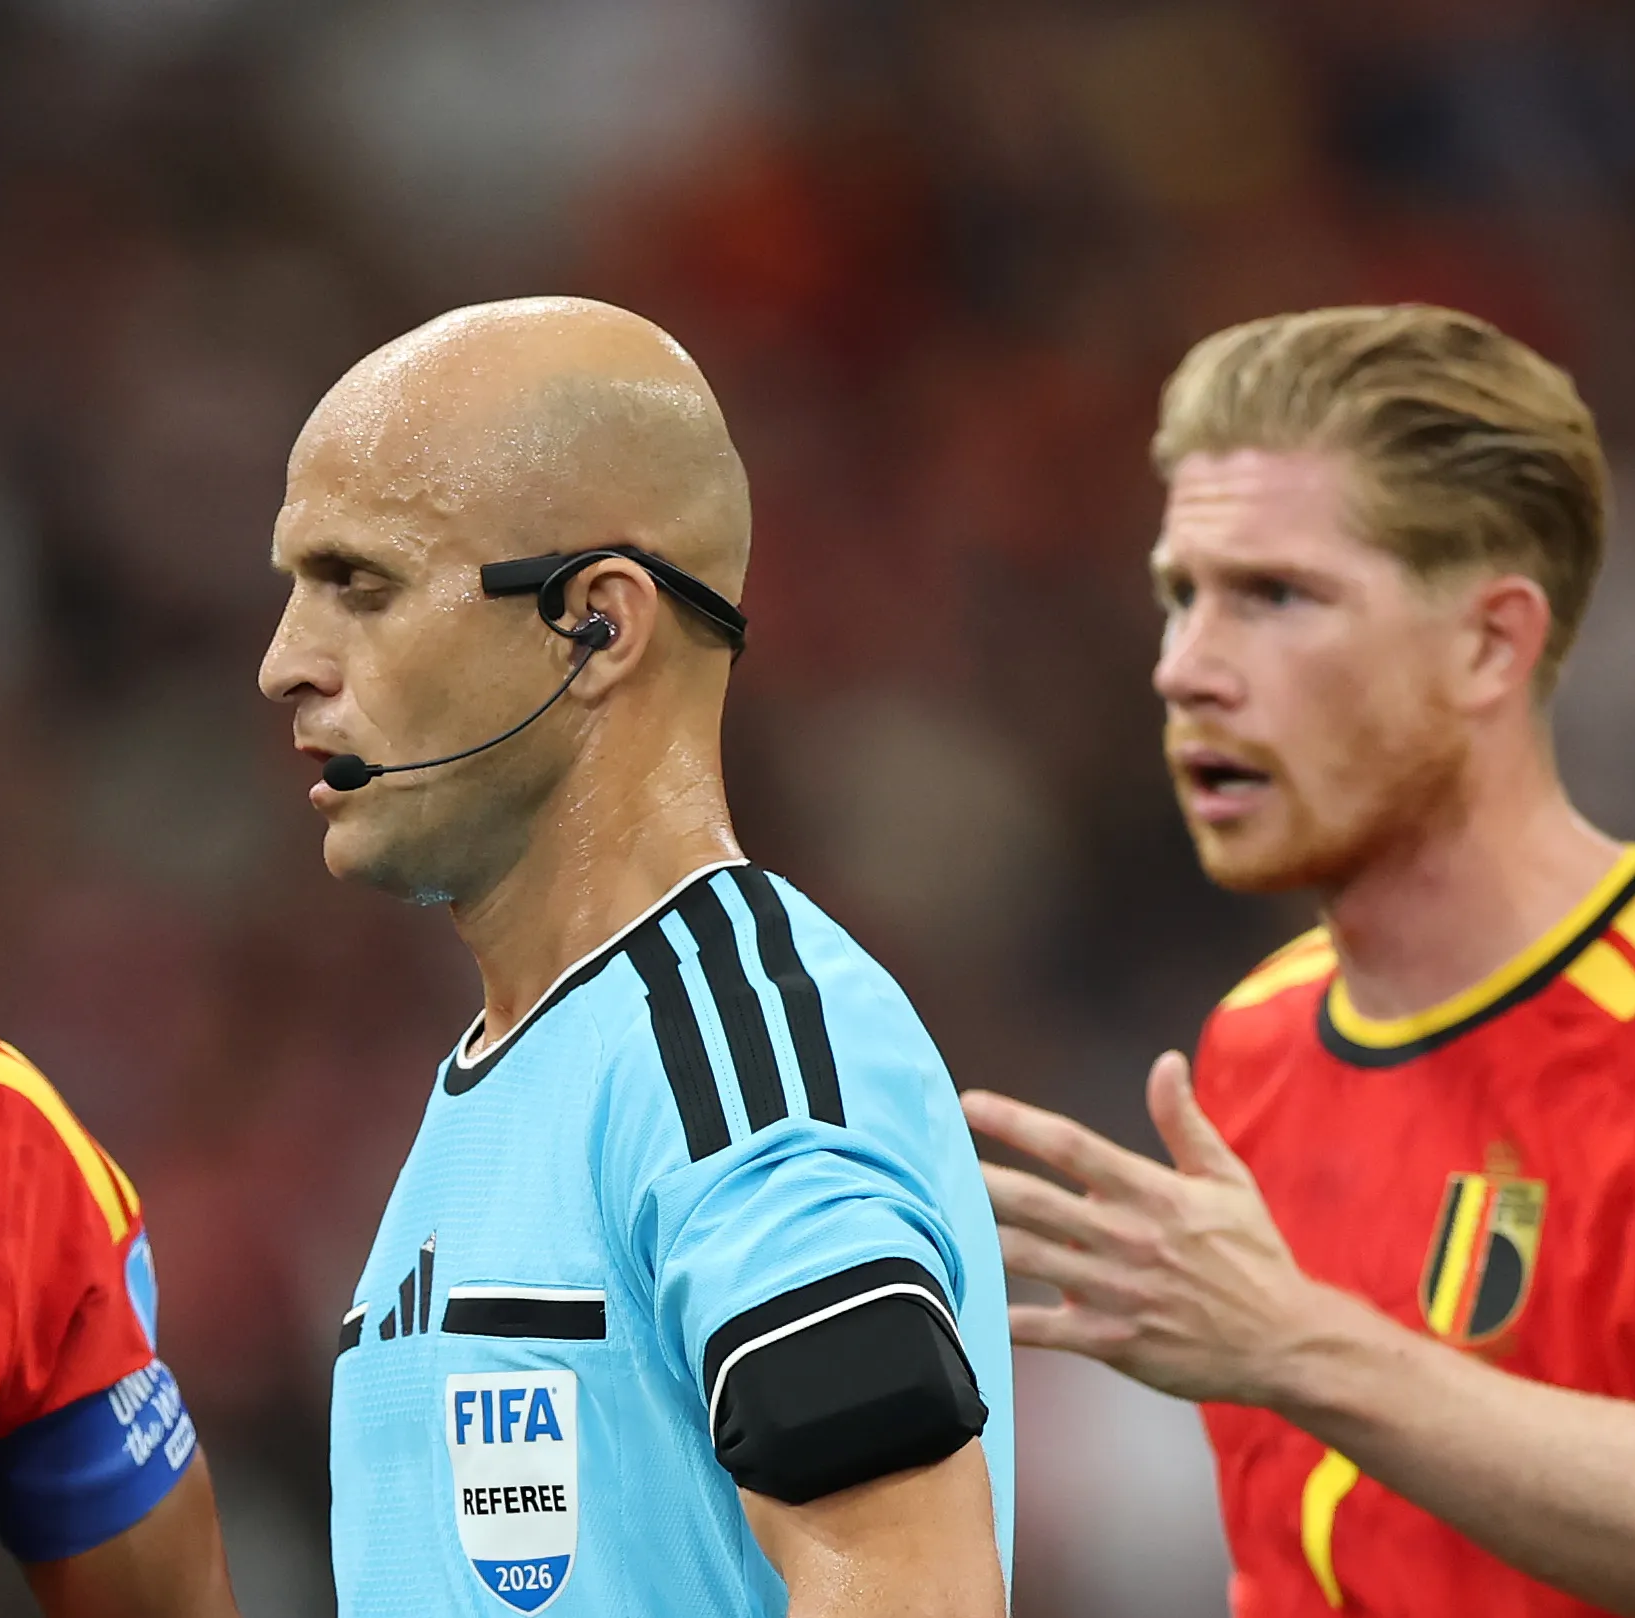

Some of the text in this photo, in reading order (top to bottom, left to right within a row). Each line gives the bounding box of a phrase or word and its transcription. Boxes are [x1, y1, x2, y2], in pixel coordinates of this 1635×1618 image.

[455, 1387, 564, 1445] FIFA
[464, 1484, 567, 1515] REFEREE
[495, 1563, 554, 1592] 2026
